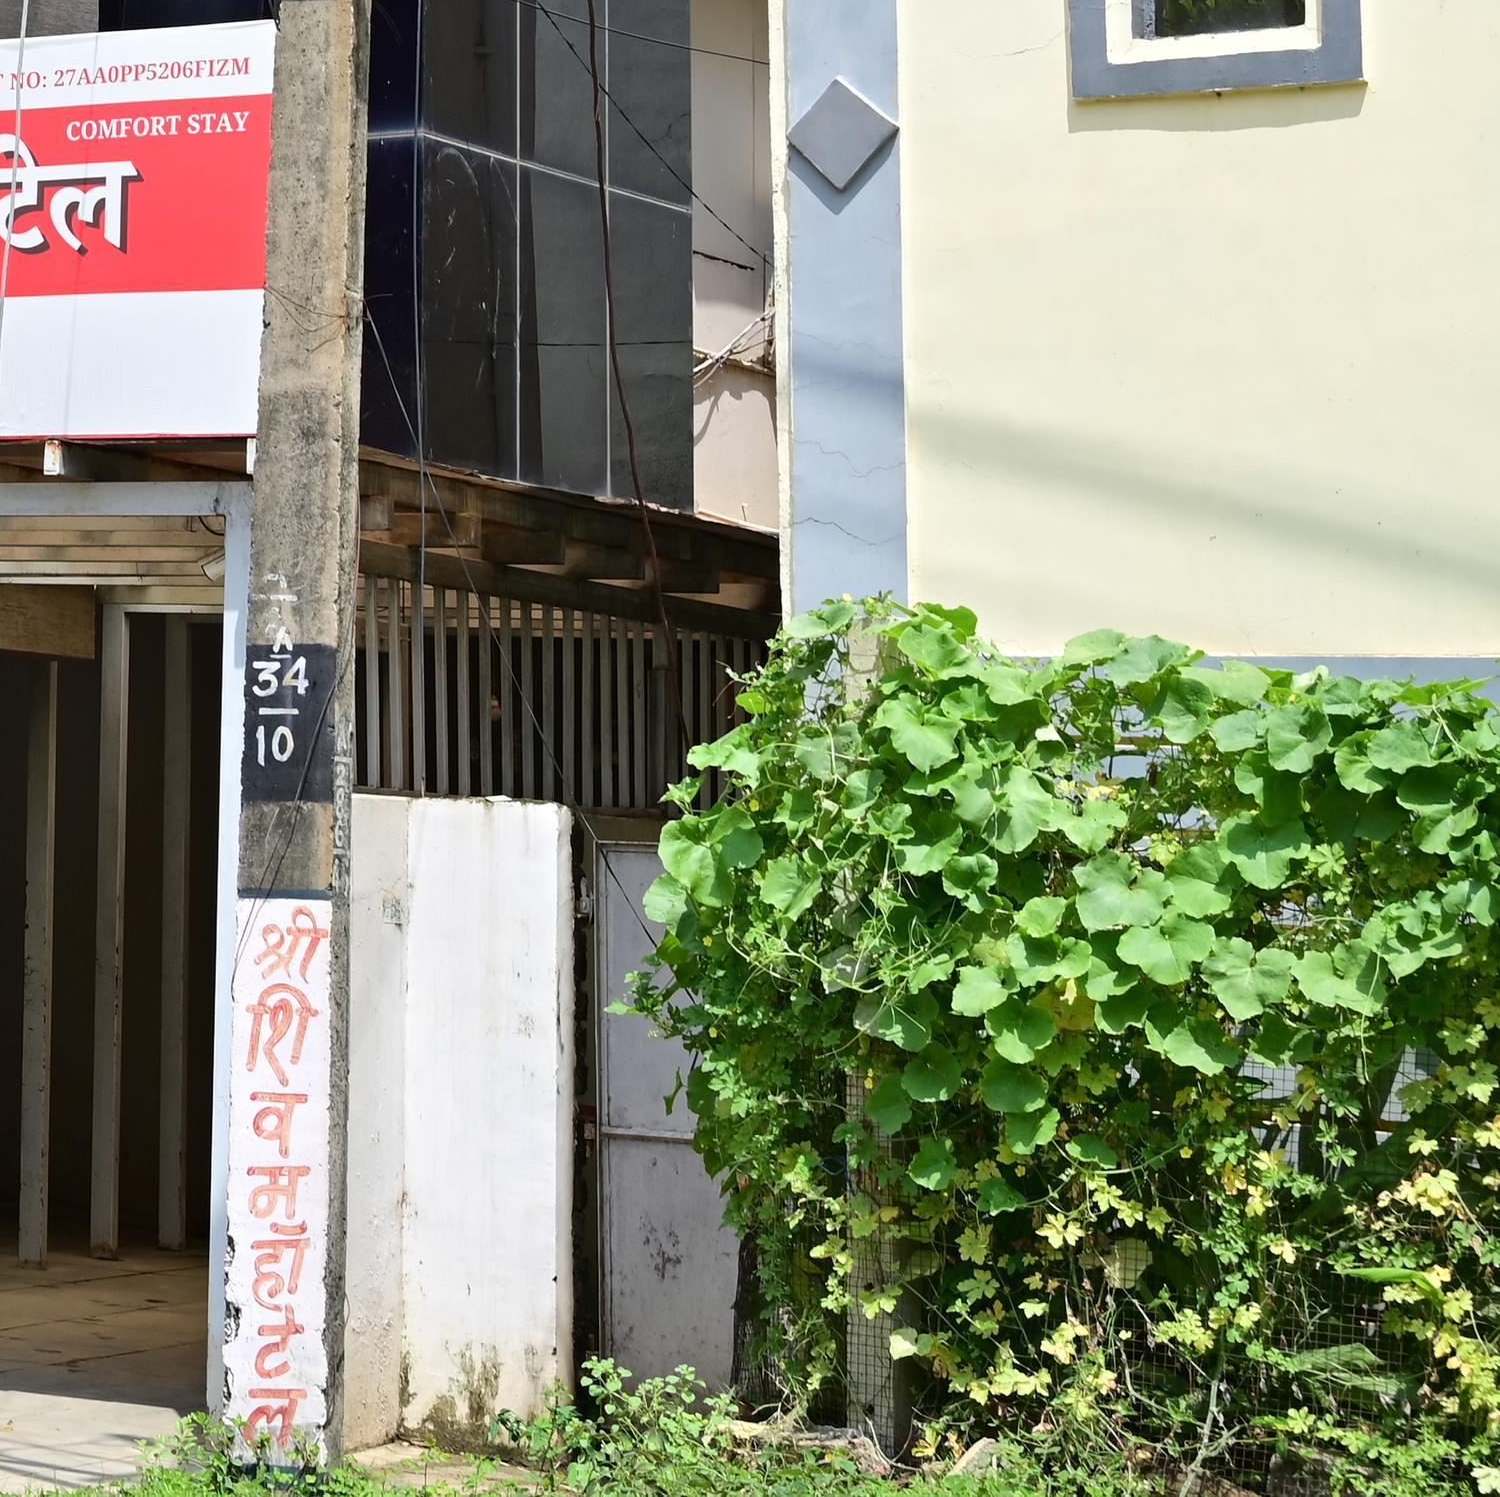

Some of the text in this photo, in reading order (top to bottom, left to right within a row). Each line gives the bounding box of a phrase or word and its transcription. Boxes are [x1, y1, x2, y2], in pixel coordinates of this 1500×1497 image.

[9, 71, 47, 91] NO:
[65, 111, 250, 142] COMFORT STAY
[272, 625, 294, 654] A
[251, 655, 310, 698] 34
[255, 724, 296, 768] 10
